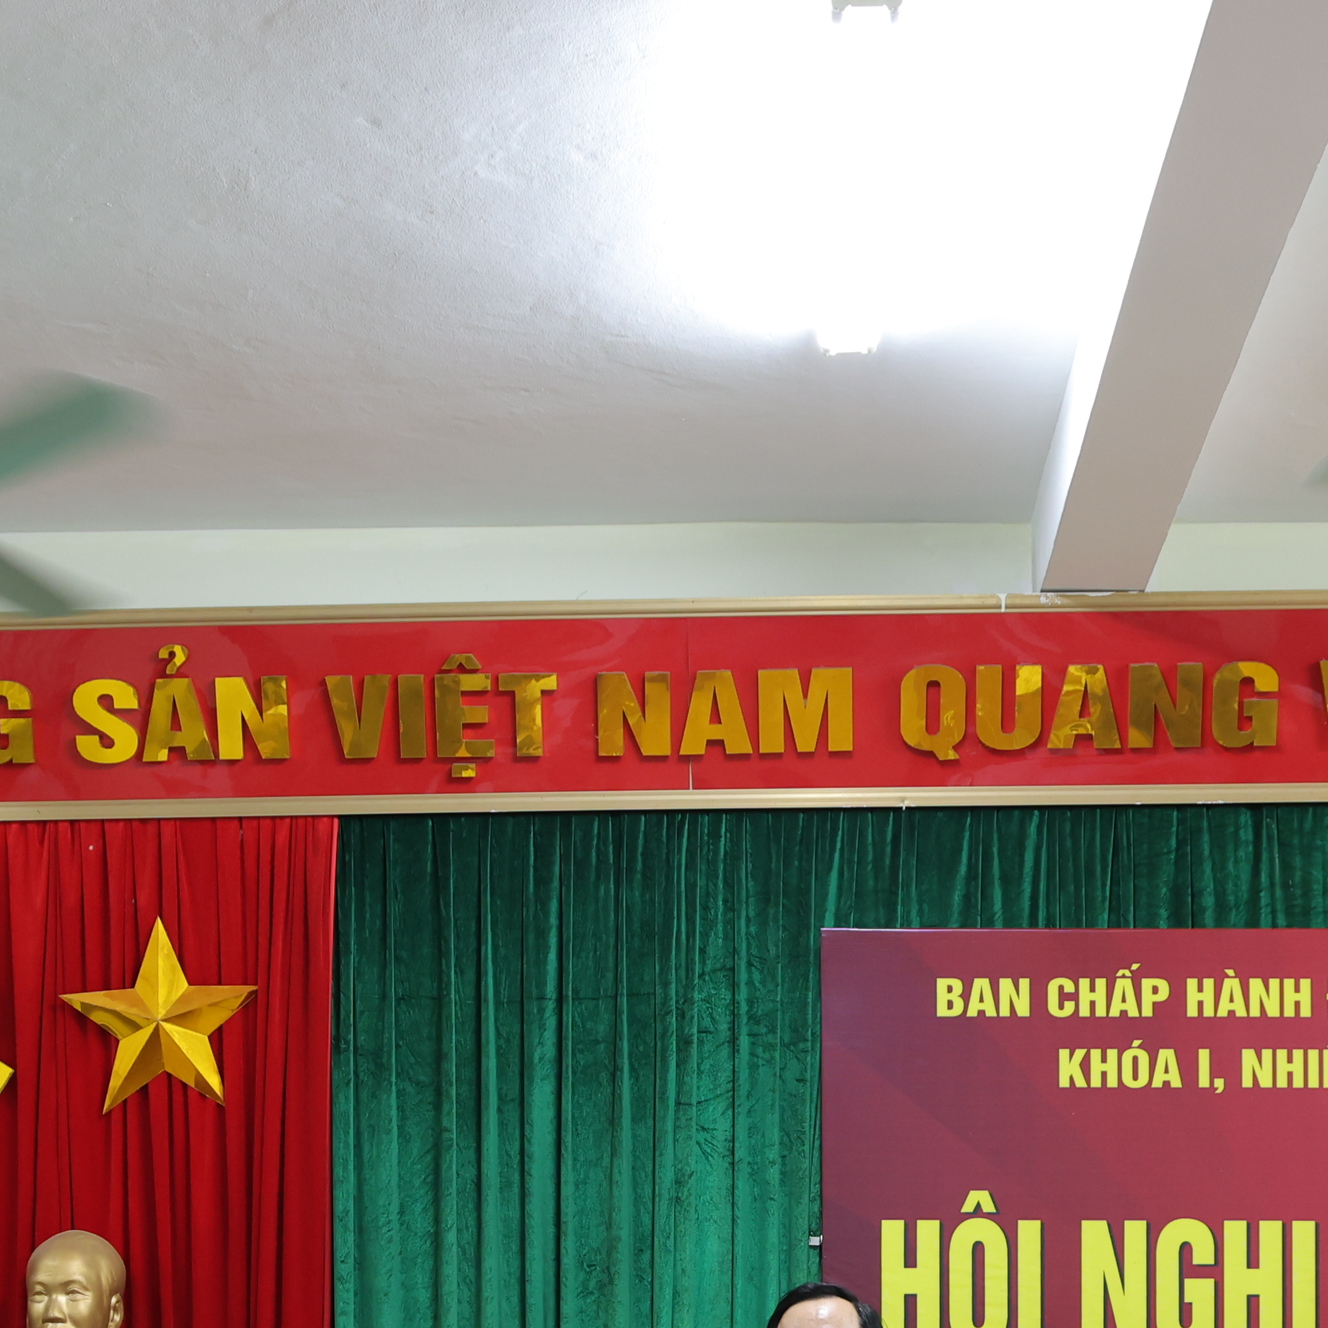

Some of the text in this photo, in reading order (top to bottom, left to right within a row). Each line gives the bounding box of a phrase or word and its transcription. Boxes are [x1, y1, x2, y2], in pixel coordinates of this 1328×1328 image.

[72, 644, 291, 764] SẢN
[325, 653, 558, 778] VIỆT
[597, 667, 854, 757] NAM
[900, 661, 1279, 761] QUANG
[936, 977, 1031, 1018] BAN
[1047, 964, 1170, 1018] CHẤP
[1186, 968, 1312, 1018] HÀNH
[1058, 1039, 1180, 1089] KHÓA
[1197, 1048, 1225, 1093] I,
